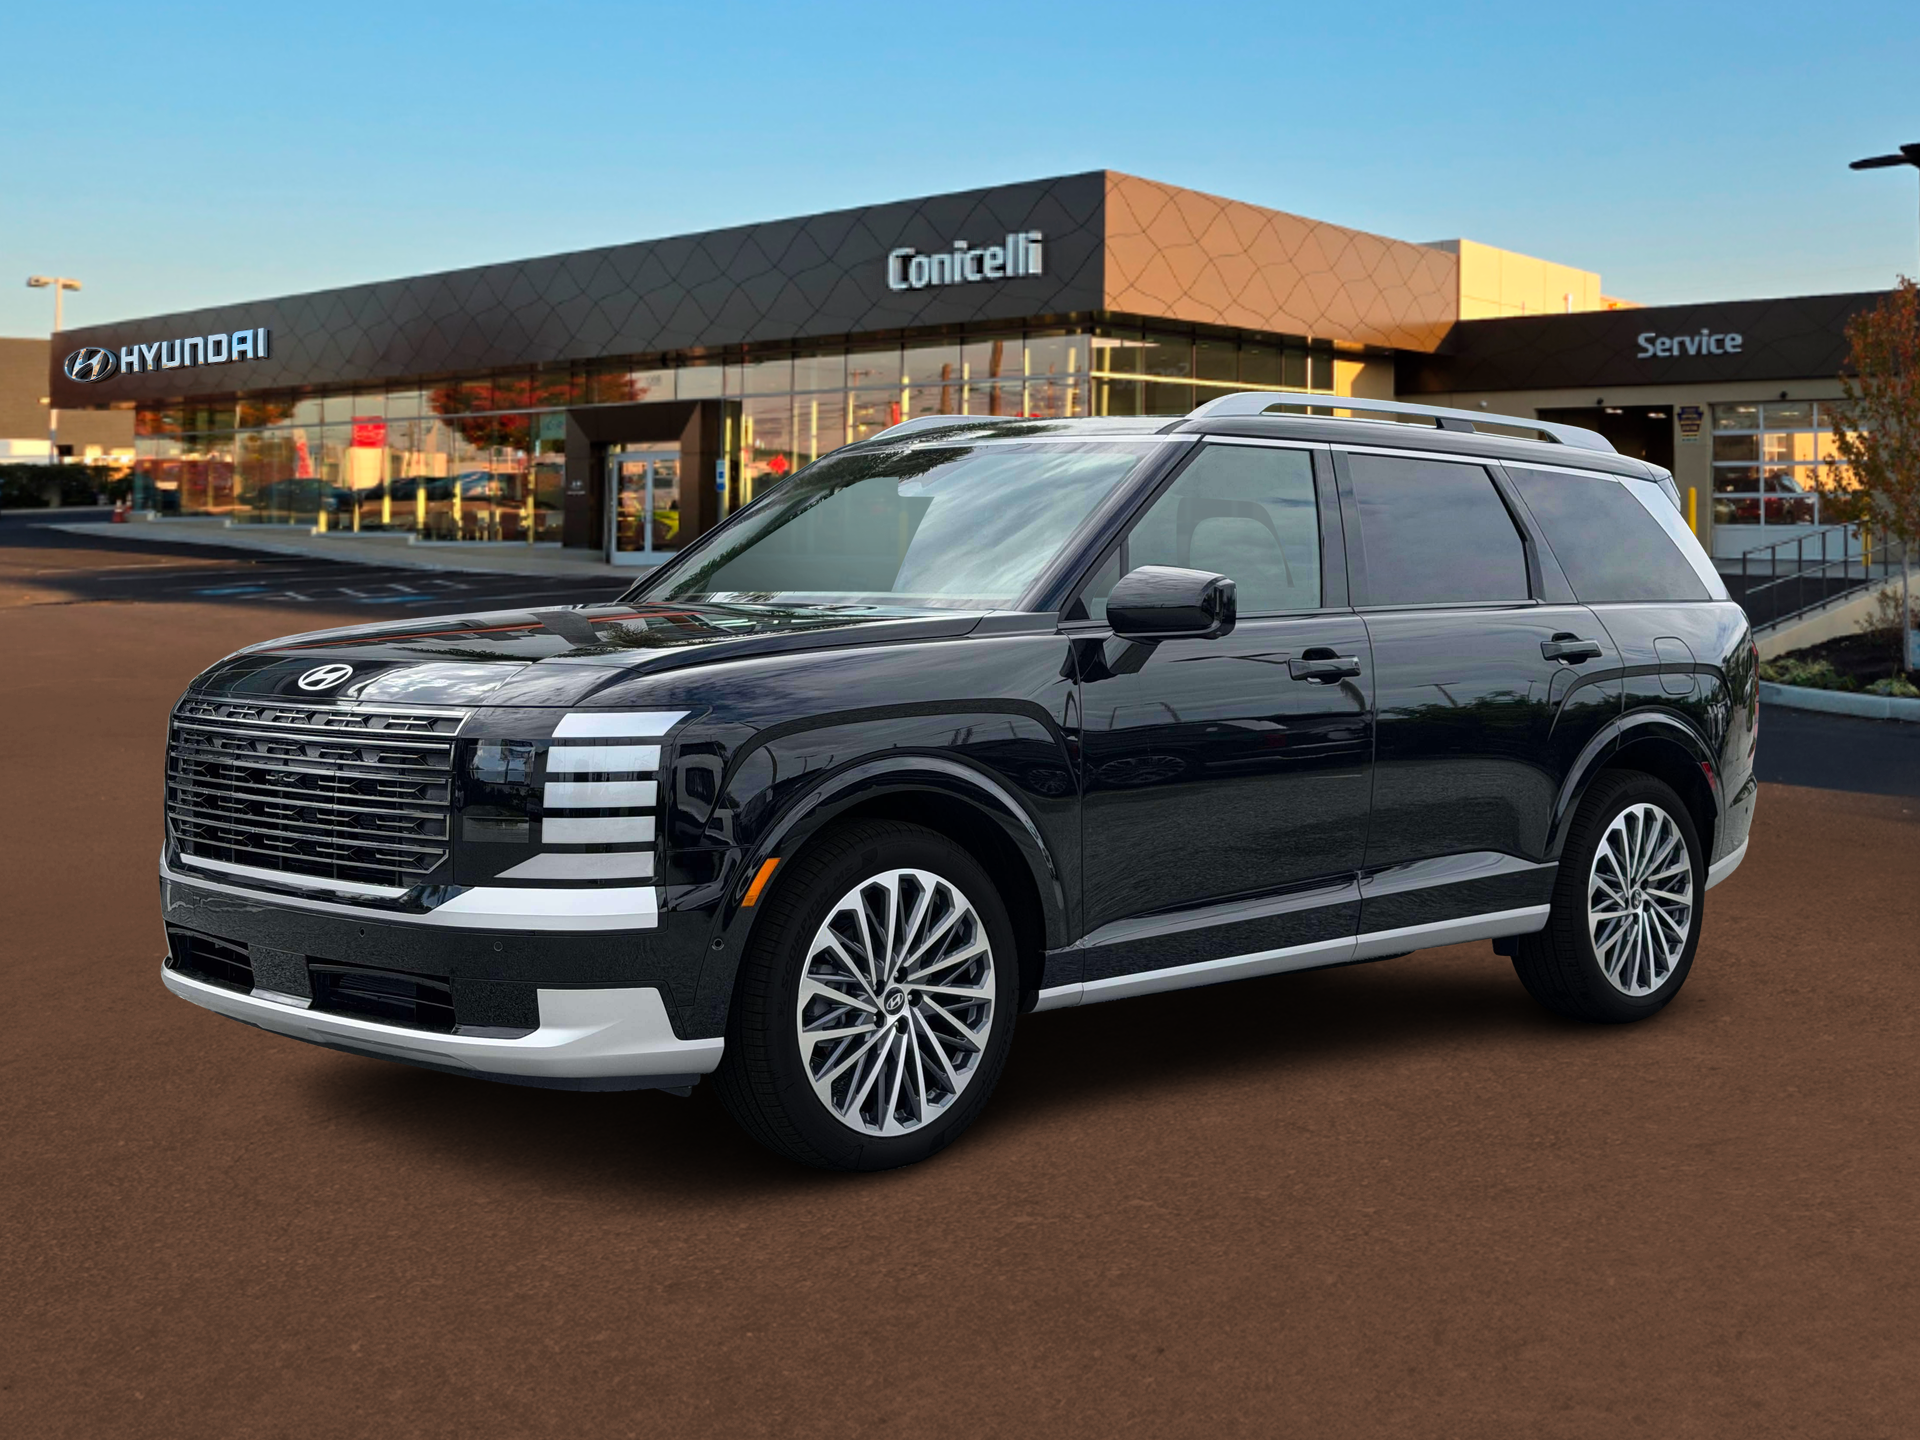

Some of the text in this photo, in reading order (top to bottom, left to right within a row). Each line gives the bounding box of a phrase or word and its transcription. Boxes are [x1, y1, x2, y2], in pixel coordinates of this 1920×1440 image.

[888, 230, 1043, 290] Conicelli
[120, 327, 269, 374] HYUNDAI
[1637, 327, 1743, 358] Service
